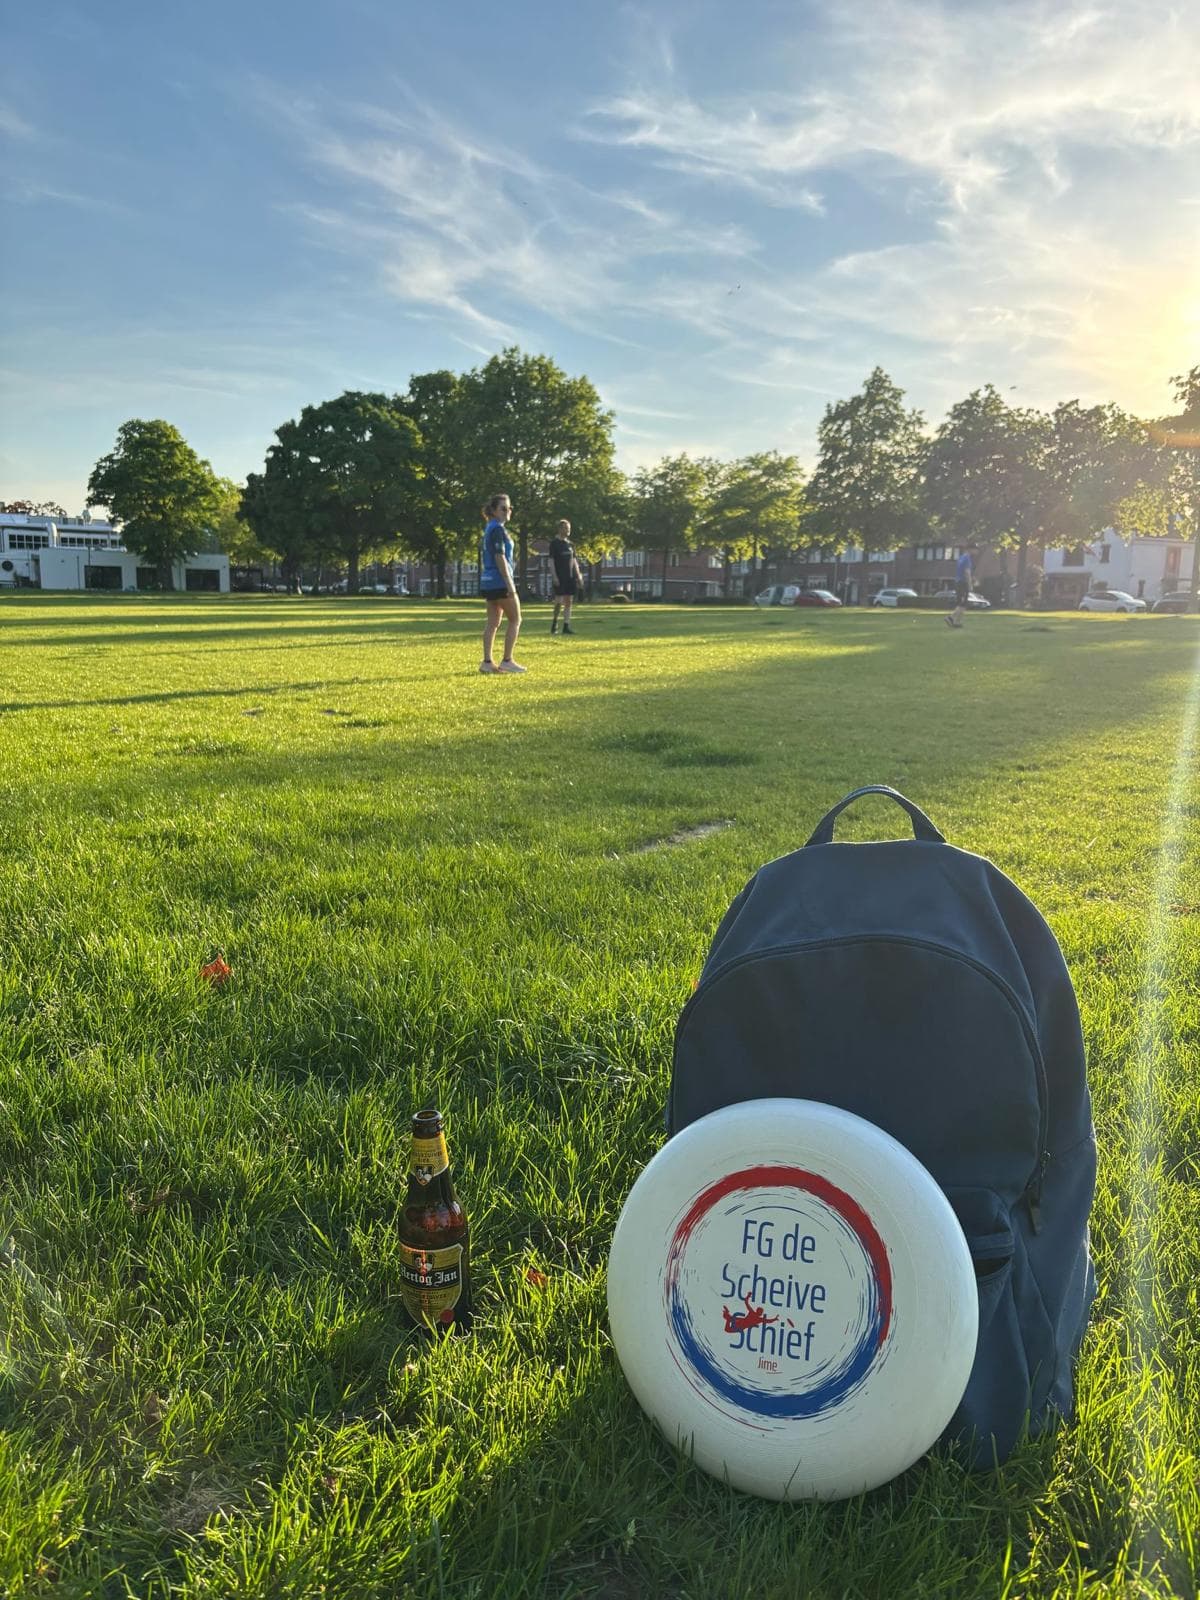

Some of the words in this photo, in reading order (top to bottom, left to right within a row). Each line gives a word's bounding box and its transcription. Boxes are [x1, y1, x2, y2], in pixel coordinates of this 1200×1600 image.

[742, 1219, 775, 1258] FG
[782, 1223, 816, 1263] de
[433, 1270, 457, 1287] Jan
[720, 1263, 826, 1314] Scheive
